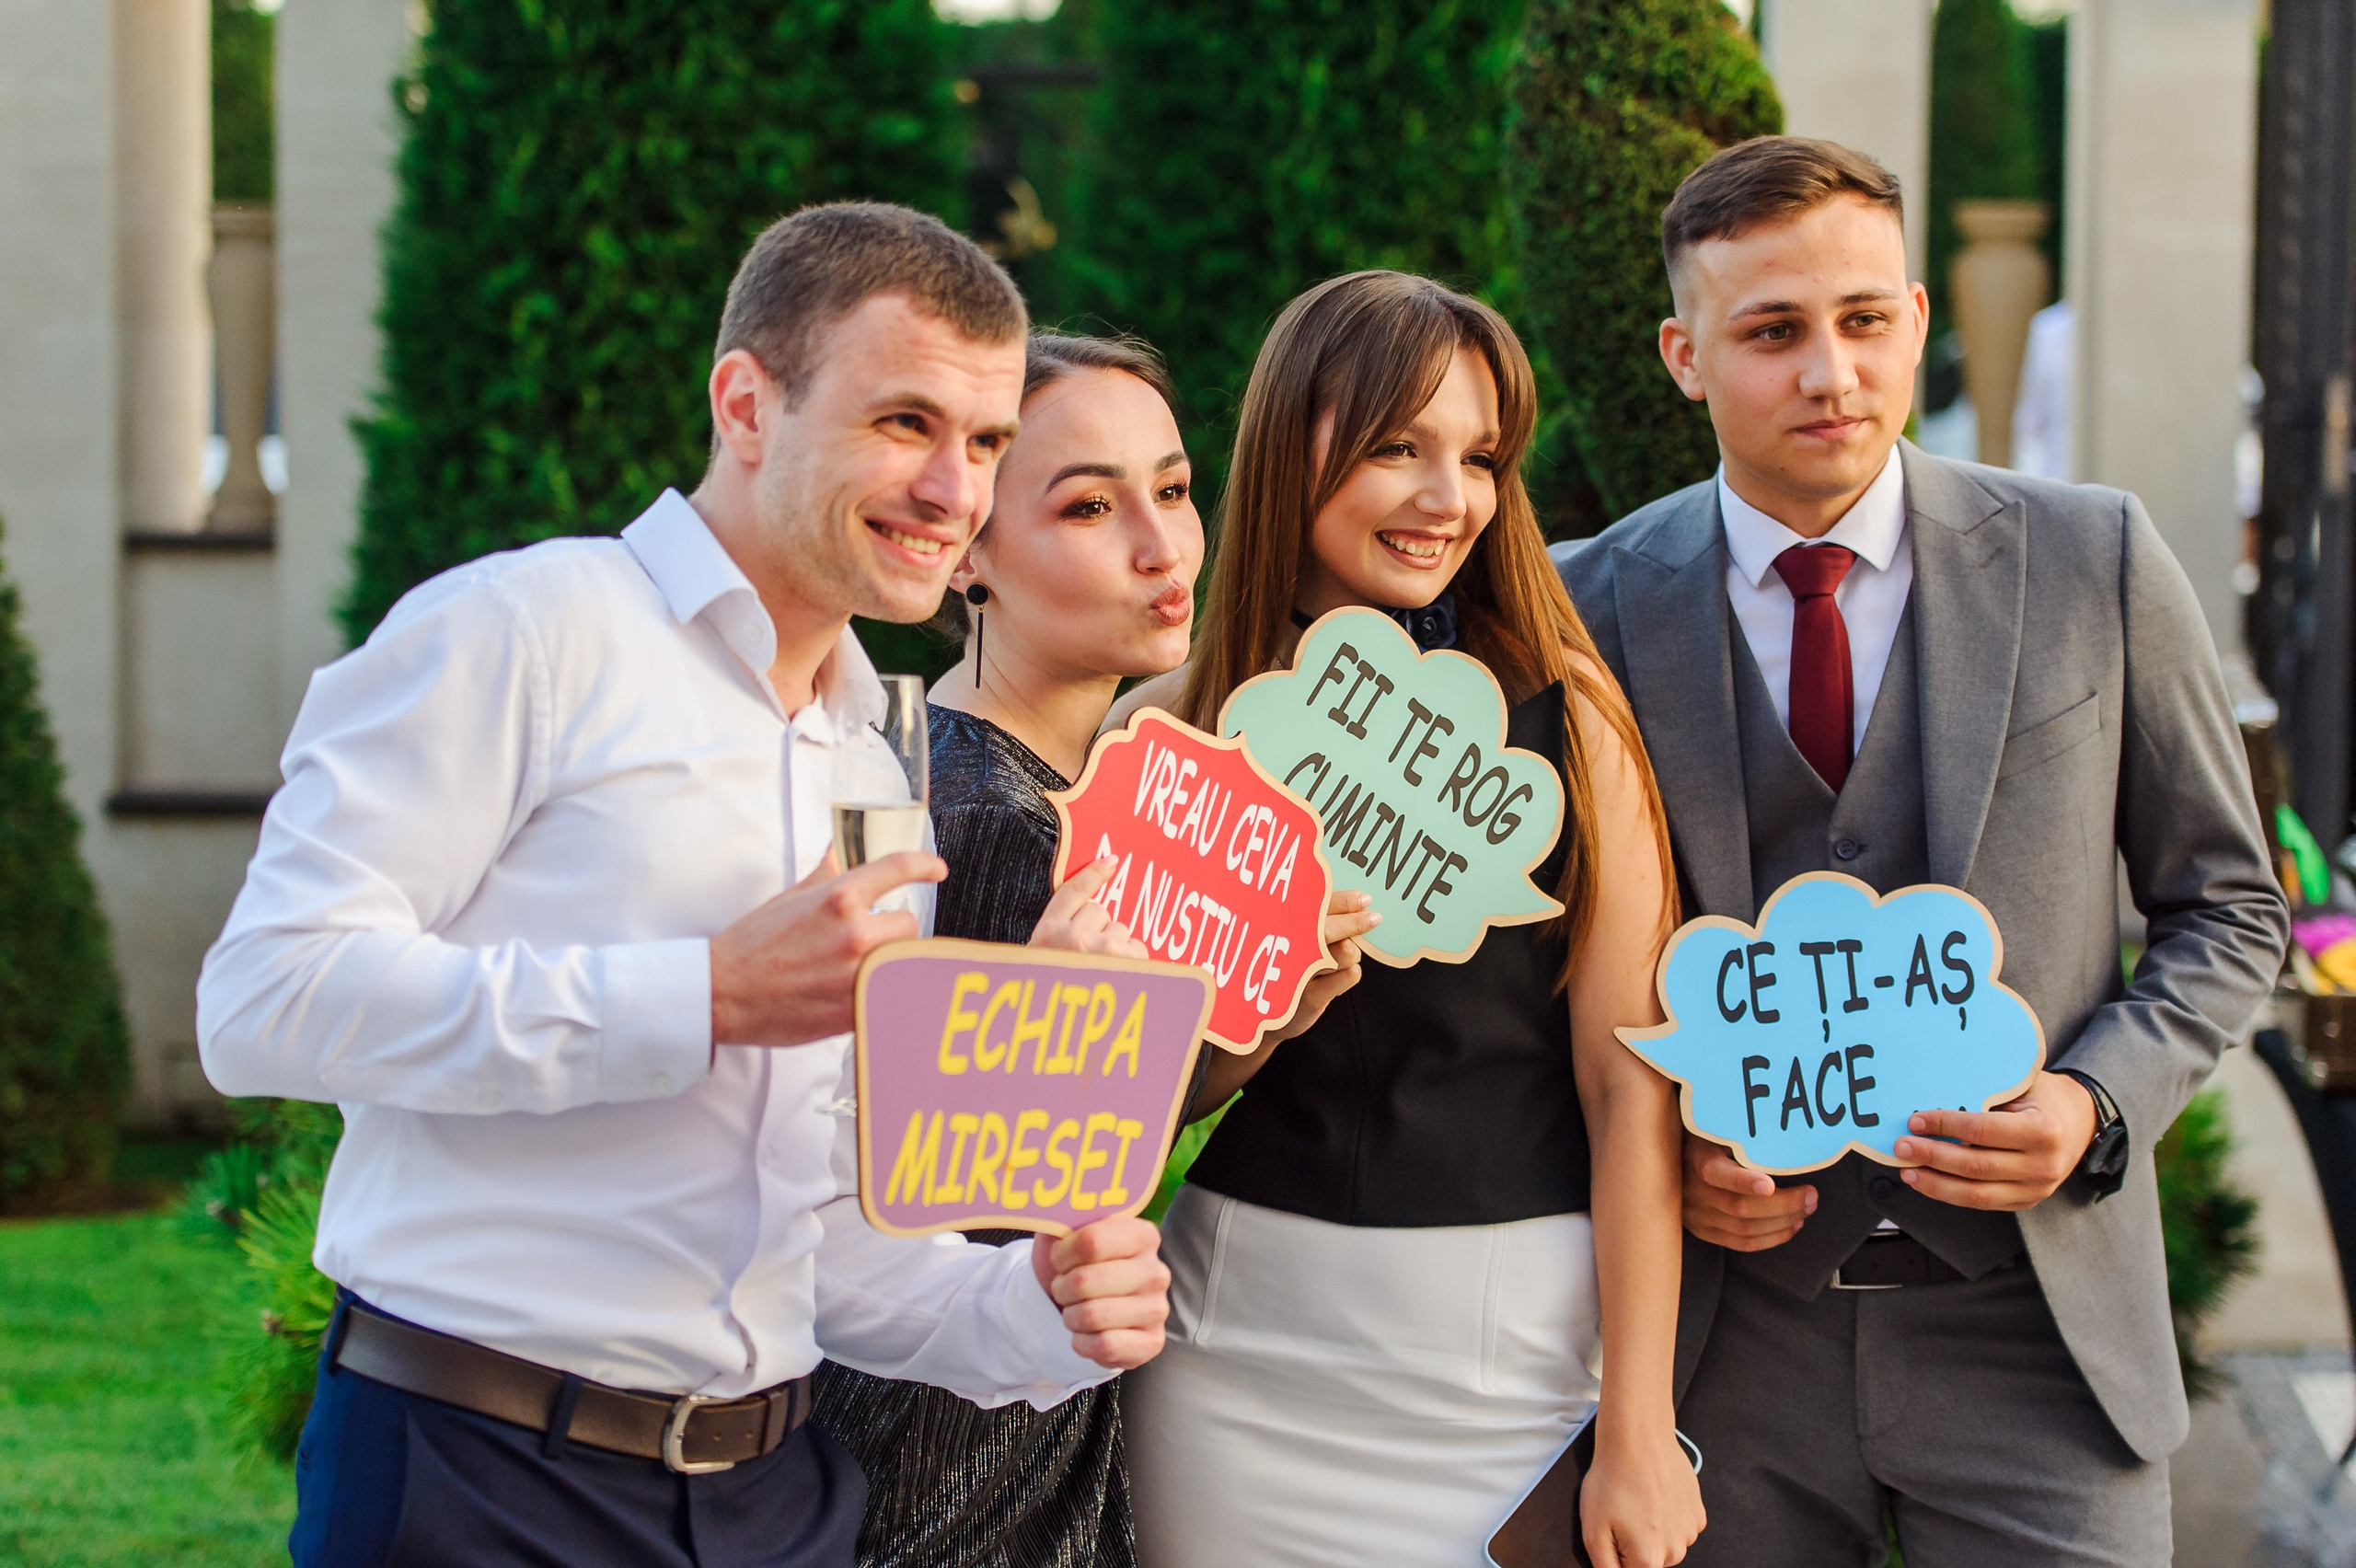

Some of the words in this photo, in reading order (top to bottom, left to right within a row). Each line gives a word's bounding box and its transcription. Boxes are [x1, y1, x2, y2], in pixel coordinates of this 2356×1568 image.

[1306, 642, 1394, 740] FII
[1388, 698, 1455, 787] TE
[1437, 743, 1533, 845] ROG
[1134, 740, 1231, 857] VREAU
[1226, 803, 1300, 903] CEVA
[938, 971, 1147, 1078] ECHIPA
[1243, 934, 1290, 1014] CE
[1716, 941, 1780, 1023] CE
[1742, 1043, 1879, 1137] FACE
[884, 1109, 1143, 1210] MIRESEI
